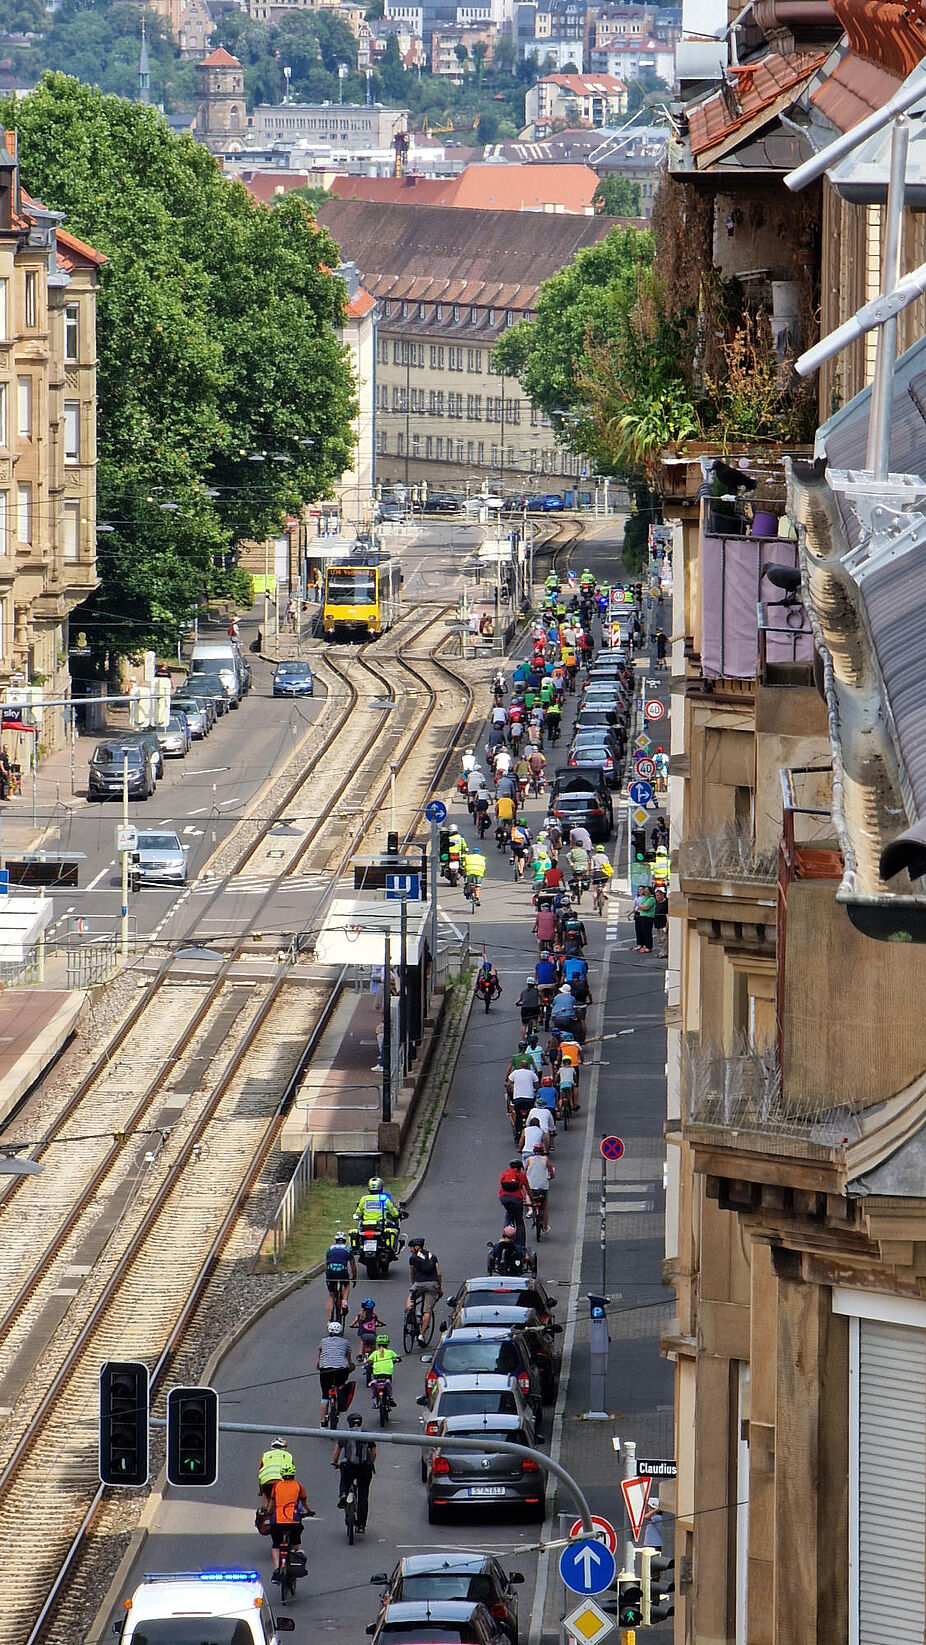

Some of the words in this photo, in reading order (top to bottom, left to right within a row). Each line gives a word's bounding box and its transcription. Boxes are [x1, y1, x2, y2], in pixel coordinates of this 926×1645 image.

[3, 709, 20, 719] sky
[649, 705, 660, 715] 40
[640, 763, 652, 773] 40
[394, 876, 411, 893] U
[593, 1306, 603, 1317] P
[640, 1462, 677, 1474] Claudius
